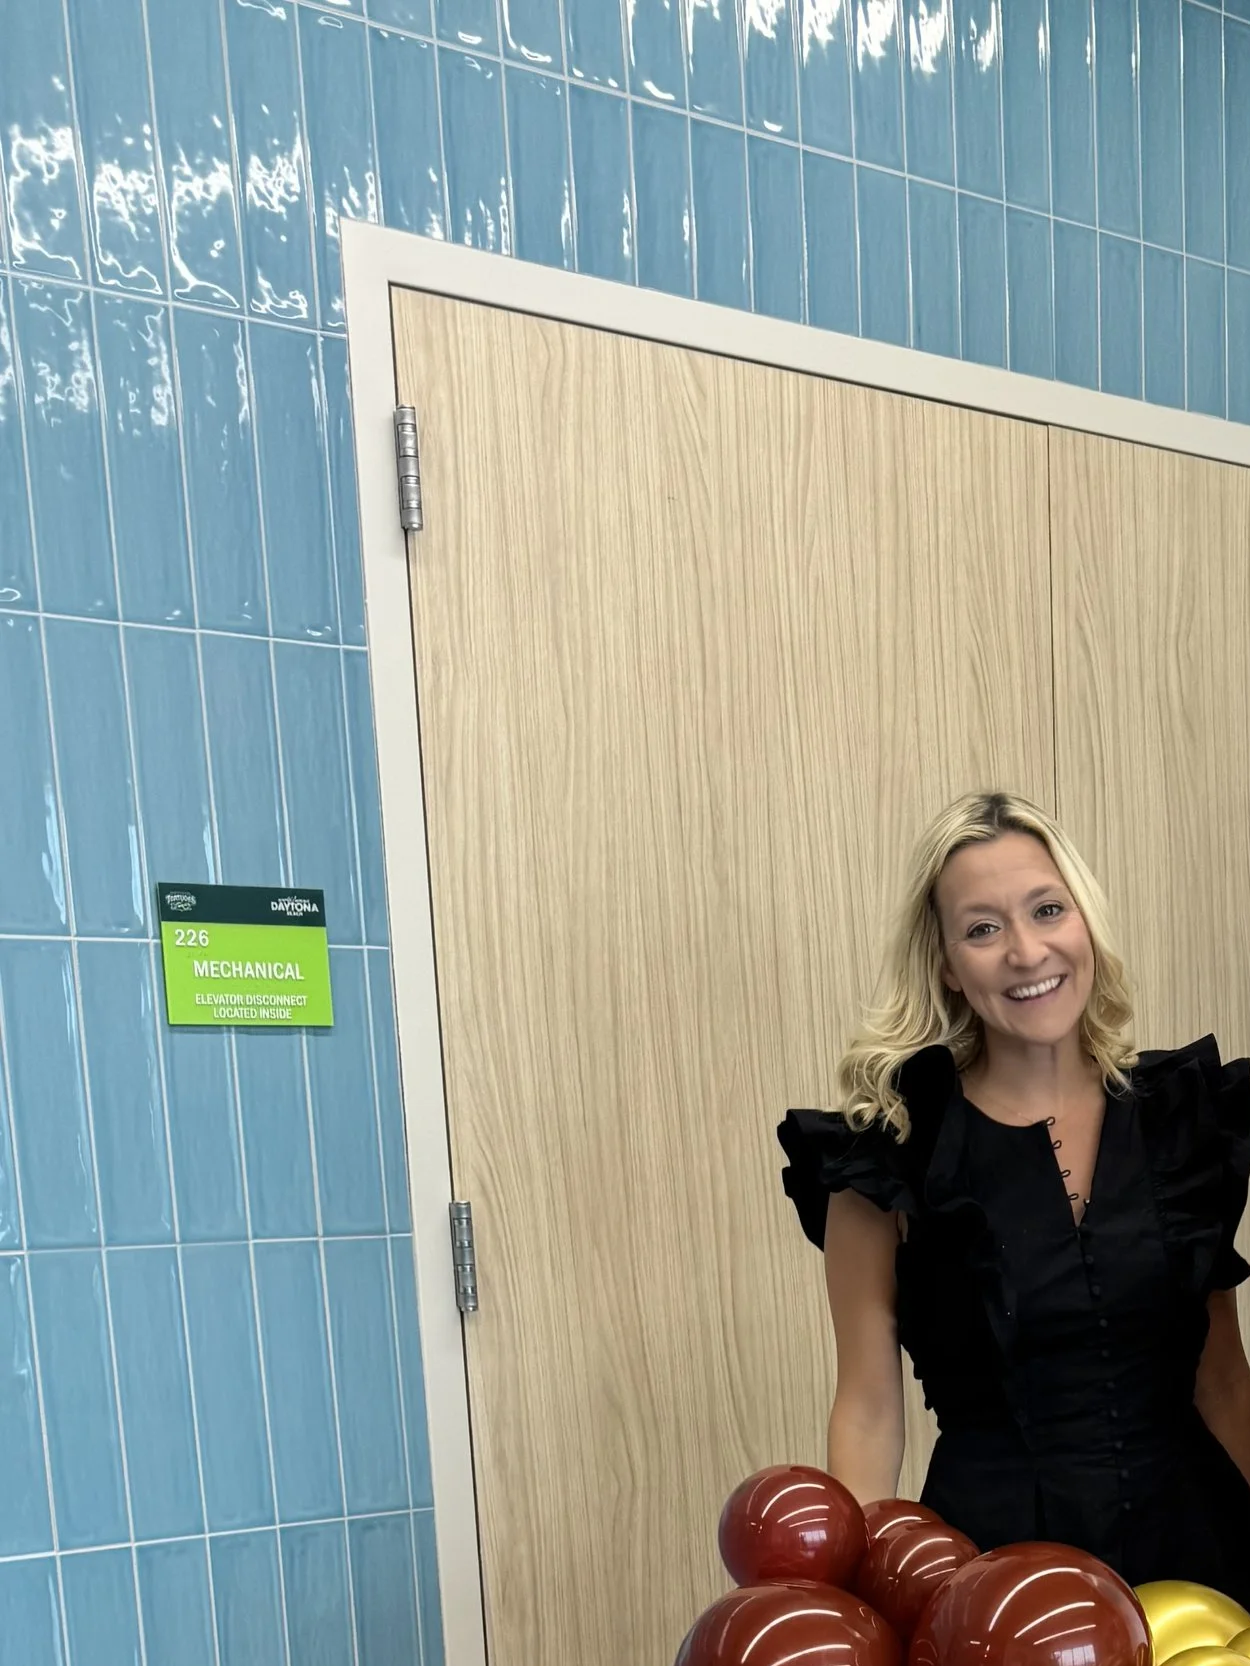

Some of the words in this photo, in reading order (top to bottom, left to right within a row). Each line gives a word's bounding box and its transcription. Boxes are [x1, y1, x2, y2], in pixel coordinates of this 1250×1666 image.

[270, 901, 320, 913] DAYTONA
[175, 929, 209, 946] 226
[194, 960, 304, 980] MECHANICAL
[195, 994, 244, 1005] ELEVATOR
[246, 995, 307, 1006] DISCONNECT
[213, 1008, 257, 1019] LOCATED
[259, 1009, 292, 1019] INSIDE
